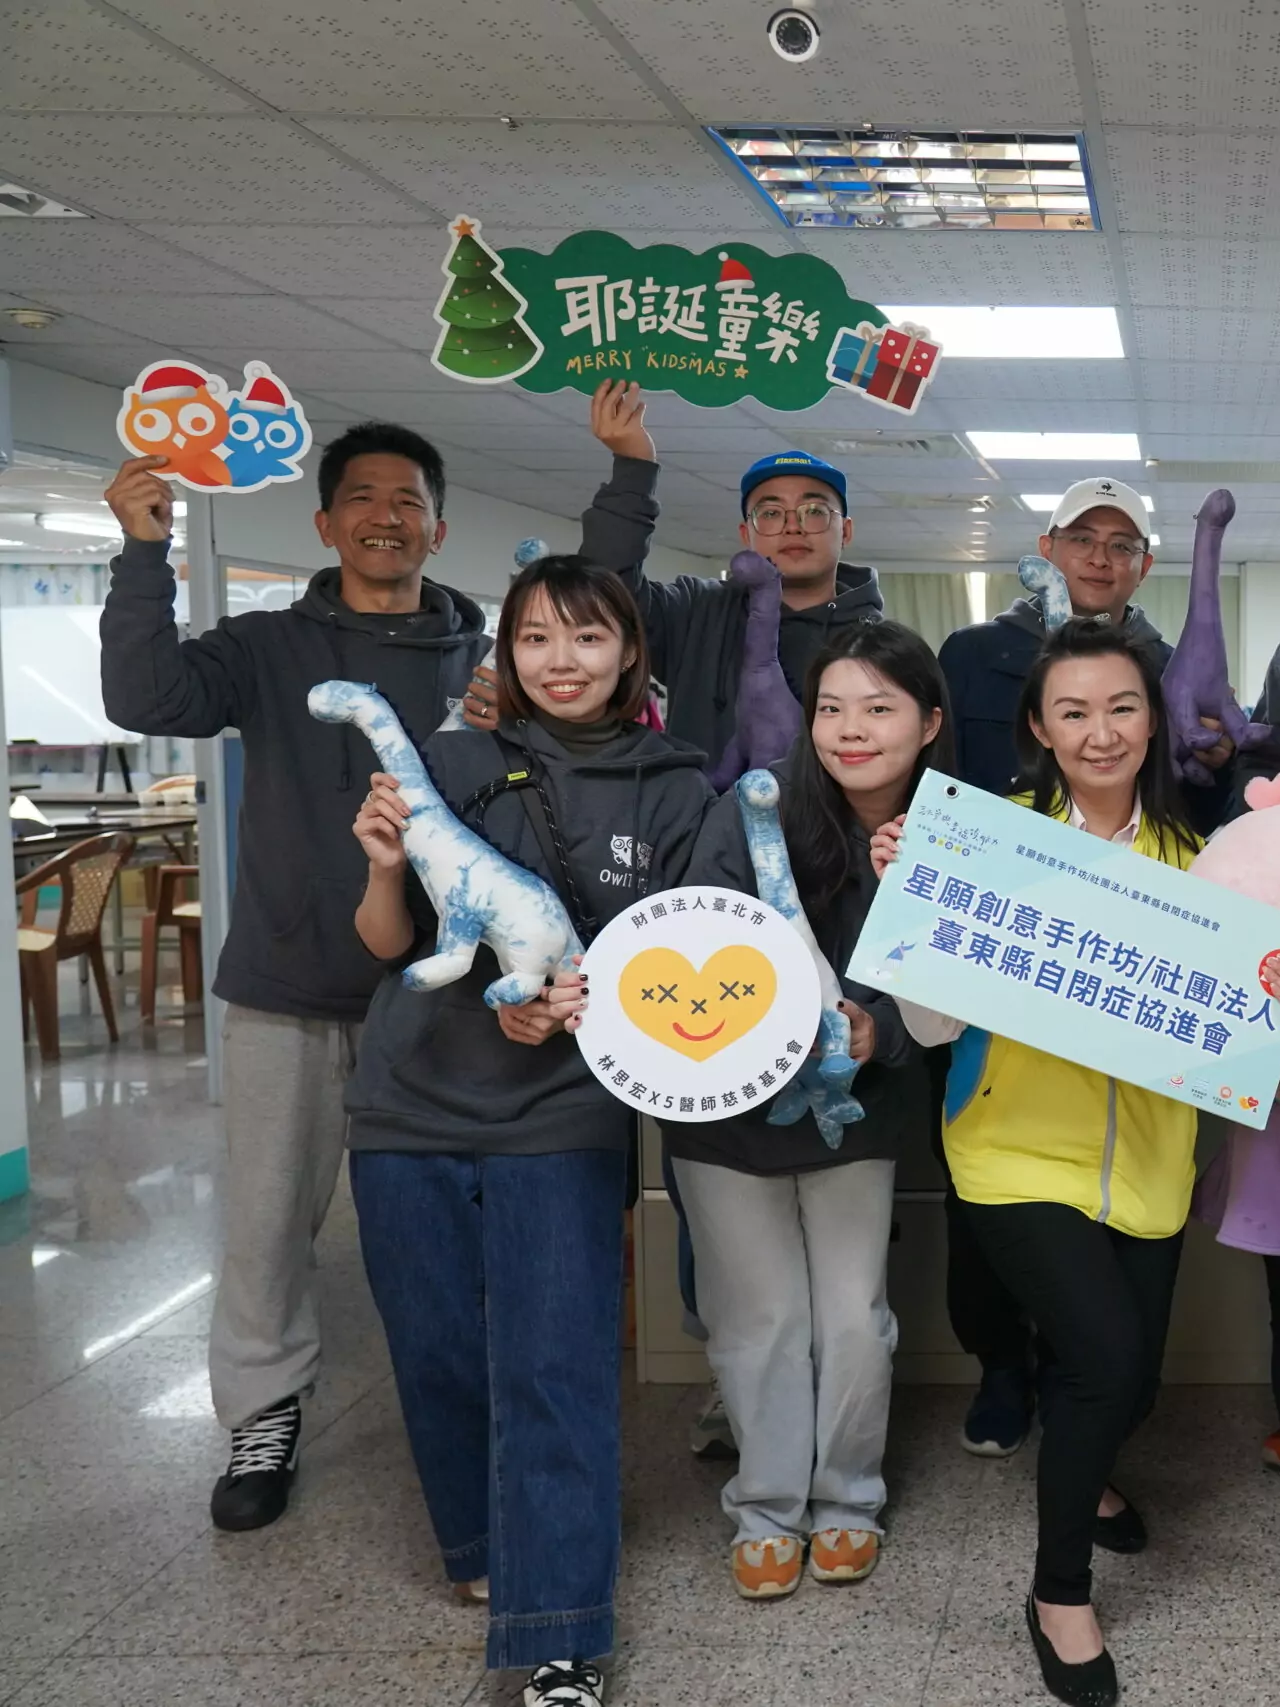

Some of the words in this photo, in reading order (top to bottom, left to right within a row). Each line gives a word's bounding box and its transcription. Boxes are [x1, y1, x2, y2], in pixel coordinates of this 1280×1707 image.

[554, 274, 820, 364] 耶誕童樂
[566, 349, 632, 374] MERRY
[631, 895, 767, 929] 財團法人臺北市
[1015, 844, 1221, 932] 星願創意手作坊/社團法人臺東縣自閉症協進會
[902, 863, 1277, 1032] 星願創意手作坊/社團法人
[929, 917, 1233, 1056] 臺東縣自閉症協進會
